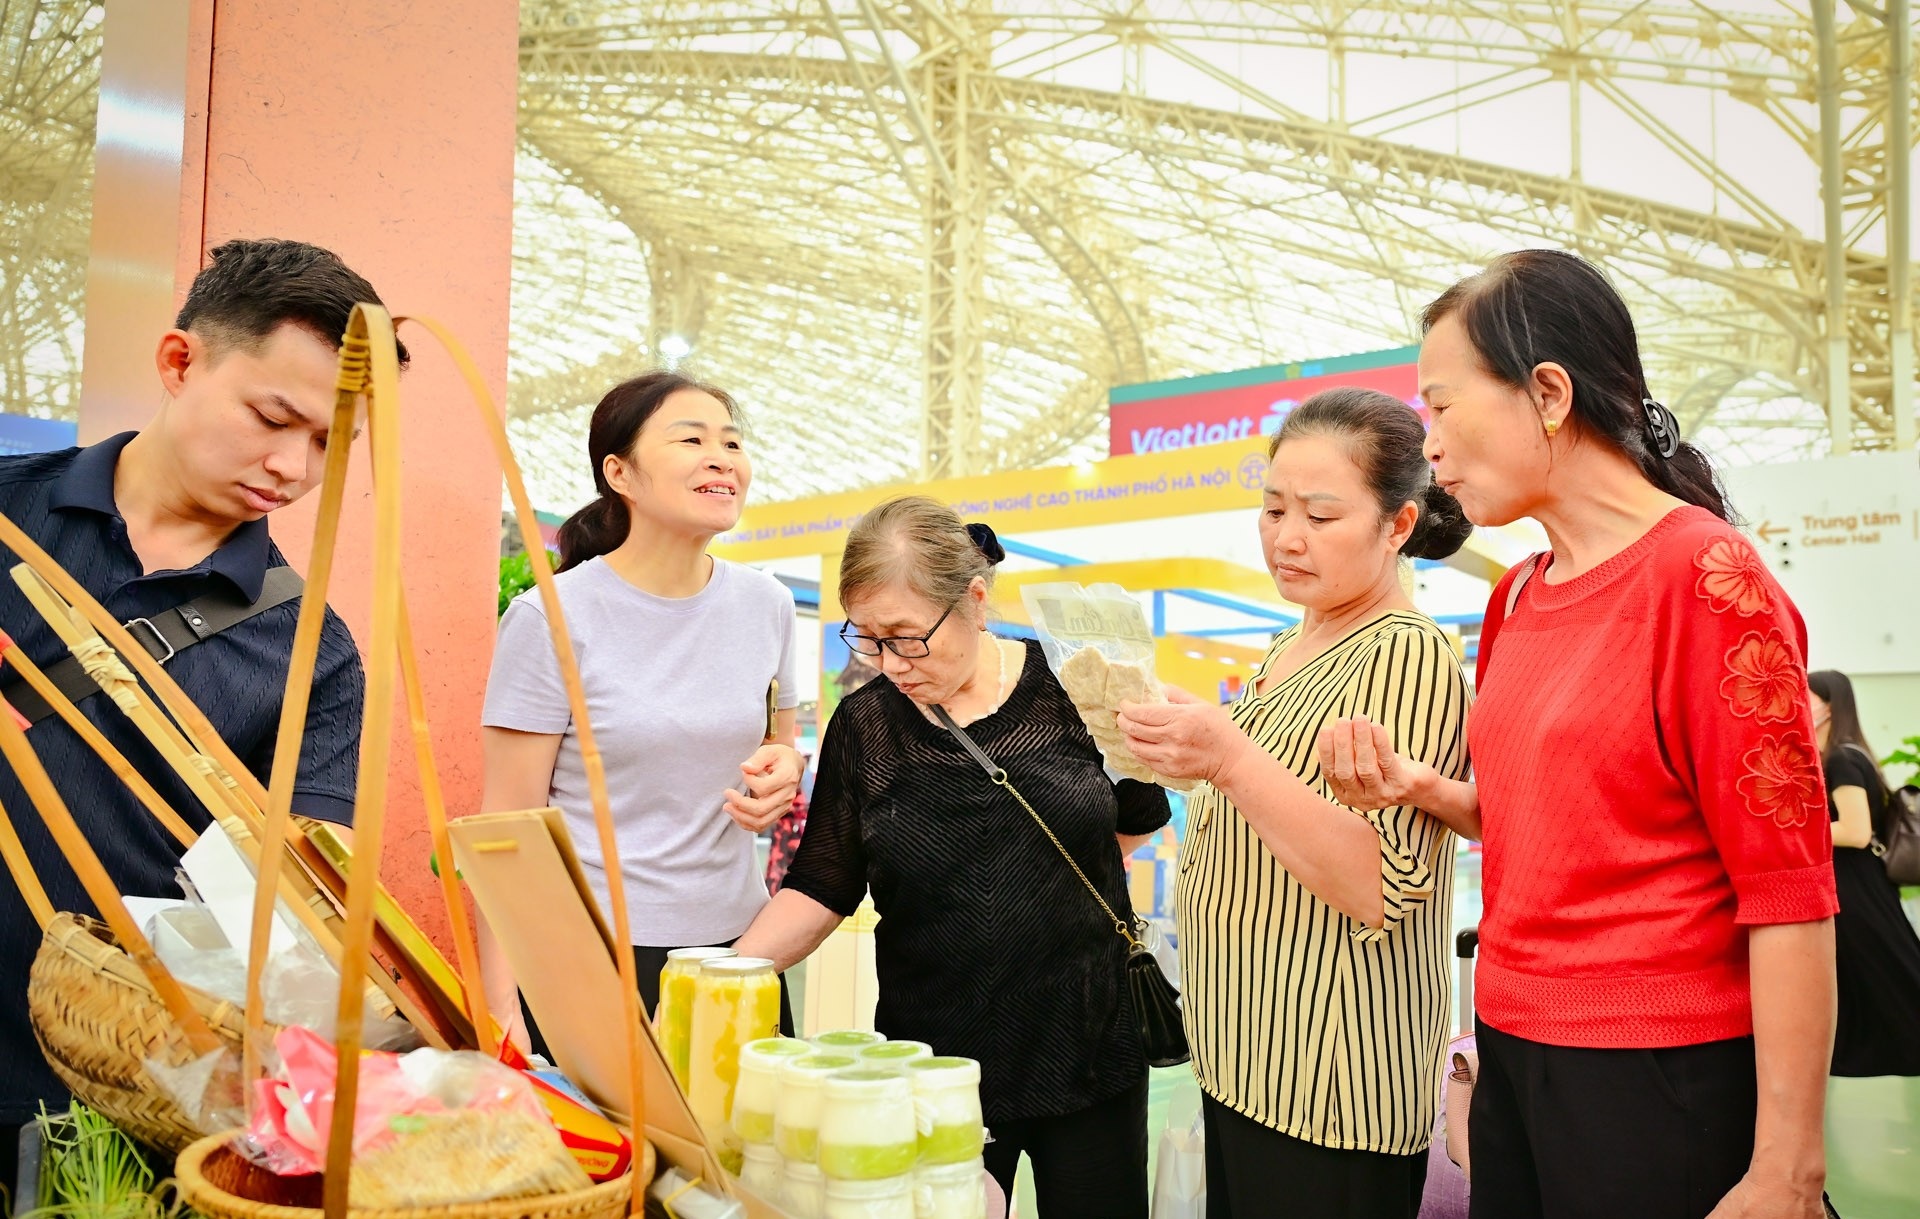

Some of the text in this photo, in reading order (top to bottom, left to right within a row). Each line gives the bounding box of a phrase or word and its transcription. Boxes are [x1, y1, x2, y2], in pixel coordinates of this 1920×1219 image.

[1131, 416, 1253, 456] Vietlott
[1037, 491, 1070, 507] CAO
[1075, 484, 1129, 503] THÀNH
[1133, 473, 1168, 496] PHỐ
[1172, 470, 1195, 491] HÀ
[1200, 466, 1231, 490] NỘI
[1802, 512, 1901, 531] Trung tâm
